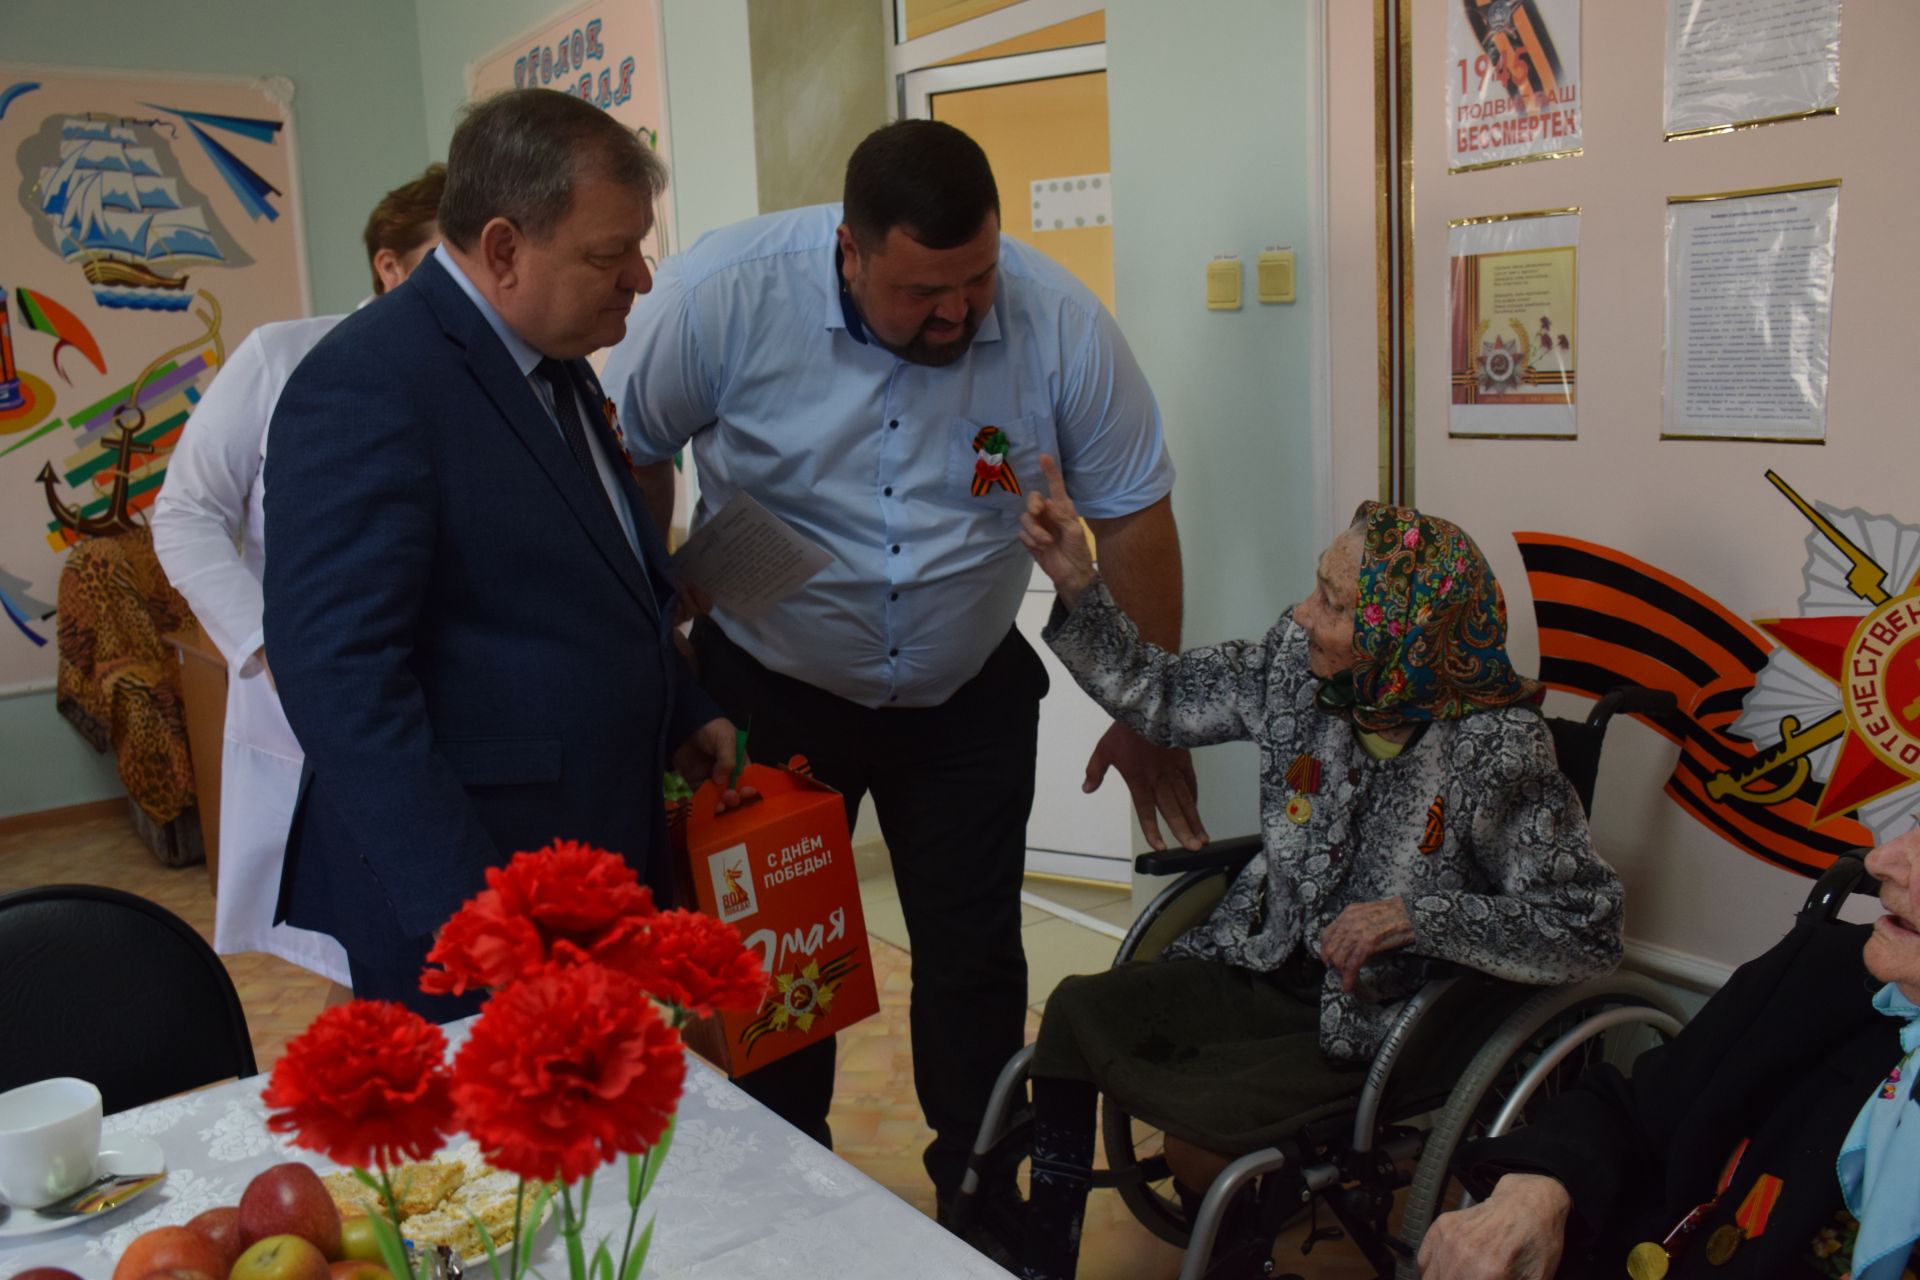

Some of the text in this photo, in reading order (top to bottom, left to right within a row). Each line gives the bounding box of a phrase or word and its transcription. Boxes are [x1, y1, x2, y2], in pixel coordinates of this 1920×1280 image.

[1457, 47, 1528, 95] 1945
[1456, 109, 1577, 153] БЕССМЕРТЕН
[763, 850, 833, 889] ПОБЕДЫ!
[767, 834, 823, 868] С ДНЁМ
